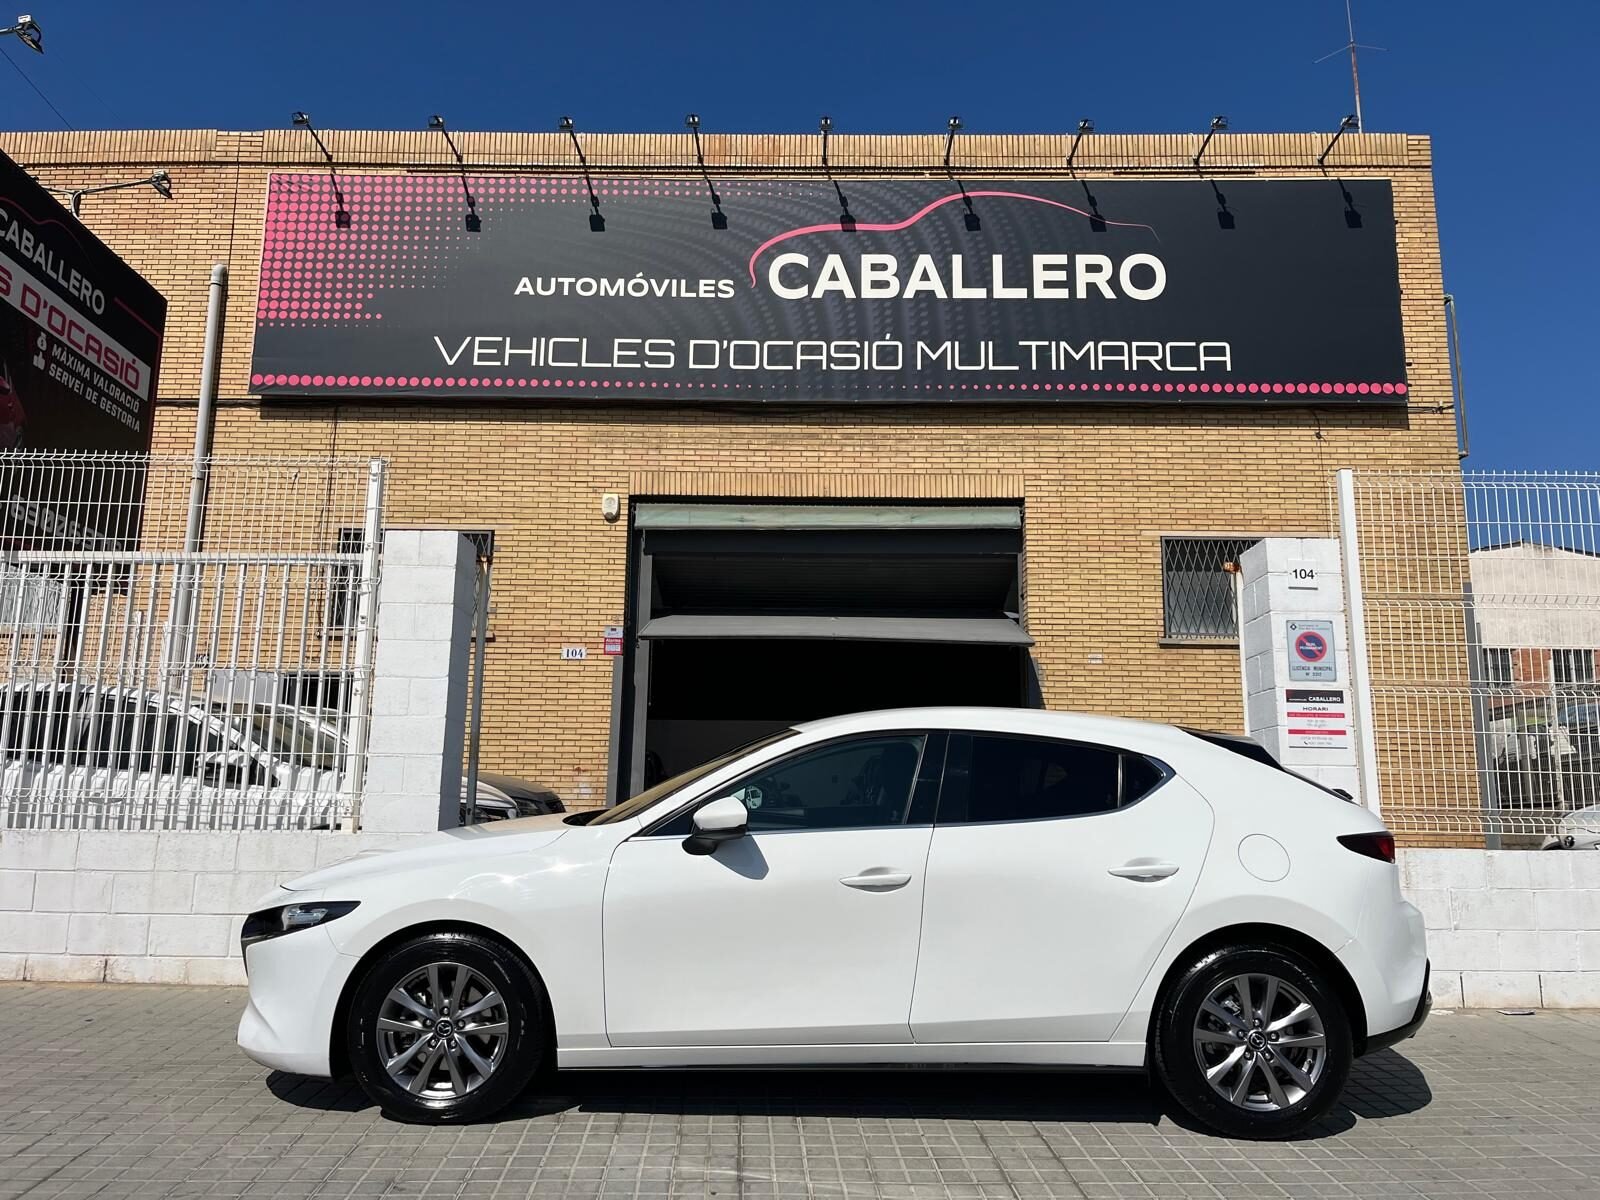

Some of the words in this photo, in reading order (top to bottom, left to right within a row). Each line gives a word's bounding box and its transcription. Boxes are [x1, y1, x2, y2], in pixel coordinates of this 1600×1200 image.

[513, 271, 735, 299] AUTOMÓVILES
[766, 252, 1167, 301] CABALLERO
[20, 282, 140, 391] D'OCASIÓ
[433, 335, 676, 370] VEHICLES
[688, 333, 903, 370] D'OCASIÓ
[916, 340, 1232, 372] MULTIMARCA
[48, 363, 84, 396] SERVEI
[86, 387, 98, 406] DE
[100, 395, 141, 433] GESTORIA
[93, 371, 140, 414] VALORACIÓ
[1292, 568, 1315, 580] 104
[566, 648, 583, 658] 104
